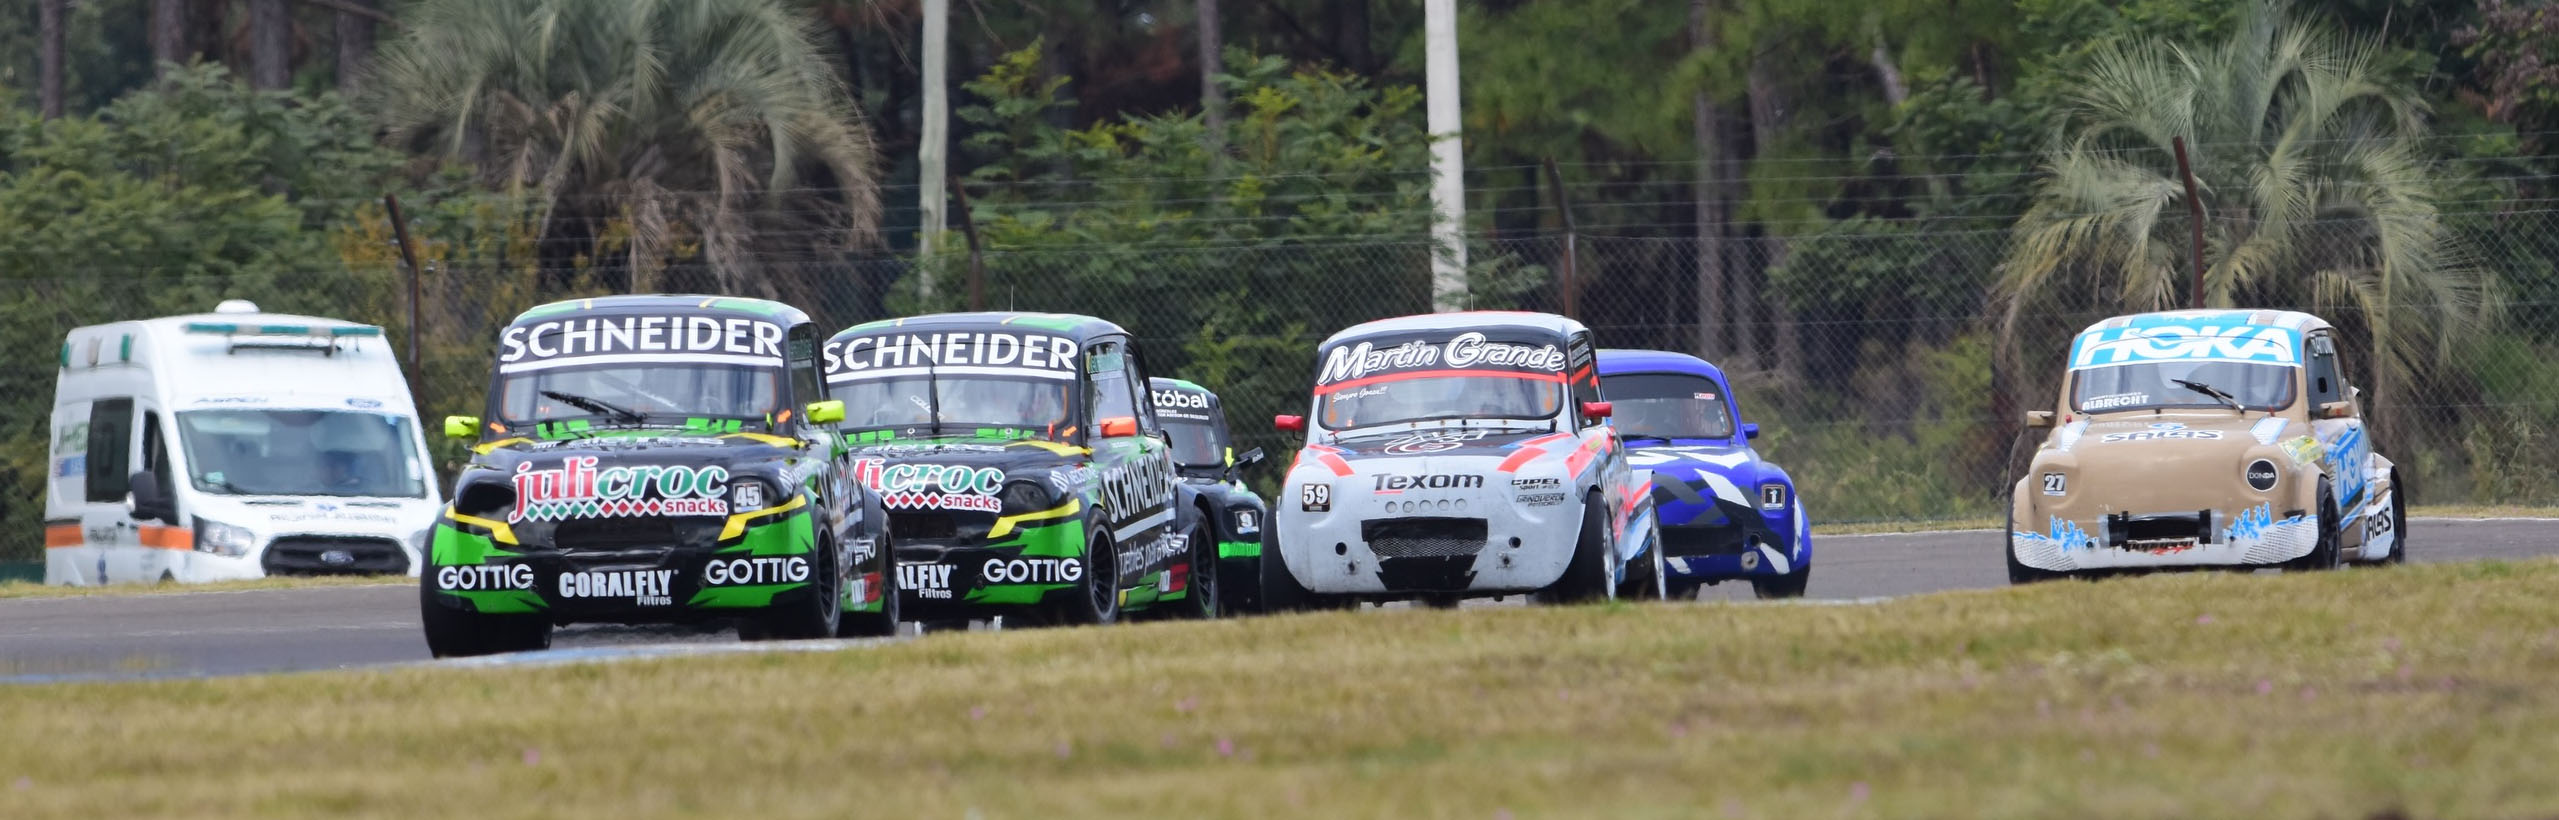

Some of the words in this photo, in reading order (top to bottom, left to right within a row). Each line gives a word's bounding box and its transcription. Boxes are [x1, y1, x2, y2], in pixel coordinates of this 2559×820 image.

[501, 317, 783, 363] SCHNEIDER
[2075, 325, 2295, 367] HOKA
[823, 333, 1078, 375] SCHNEIDER
[1317, 340, 1440, 386] Martin
[1444, 332, 1566, 371] Grande
[2082, 394, 2150, 411] ALBRECHT
[508, 456, 729, 525] julicroc
[1371, 473, 1485, 491] Texom
[1511, 478, 1561, 486] CIPEL
[2043, 474, 2066, 491] 27
[734, 484, 762, 508] 45
[943, 494, 1001, 512] snacks
[1302, 484, 1329, 504] 59
[1768, 489, 1779, 504] 1
[664, 498, 728, 517] snacks
[1240, 512, 1253, 529] 9
[437, 563, 534, 591] GOTTIG
[704, 556, 810, 585] GOTTIG
[982, 557, 1083, 583] GOTTIG
[558, 569, 672, 599] CORALFLY
[918, 587, 953, 599] Filtros
[636, 594, 672, 606] Filtros
